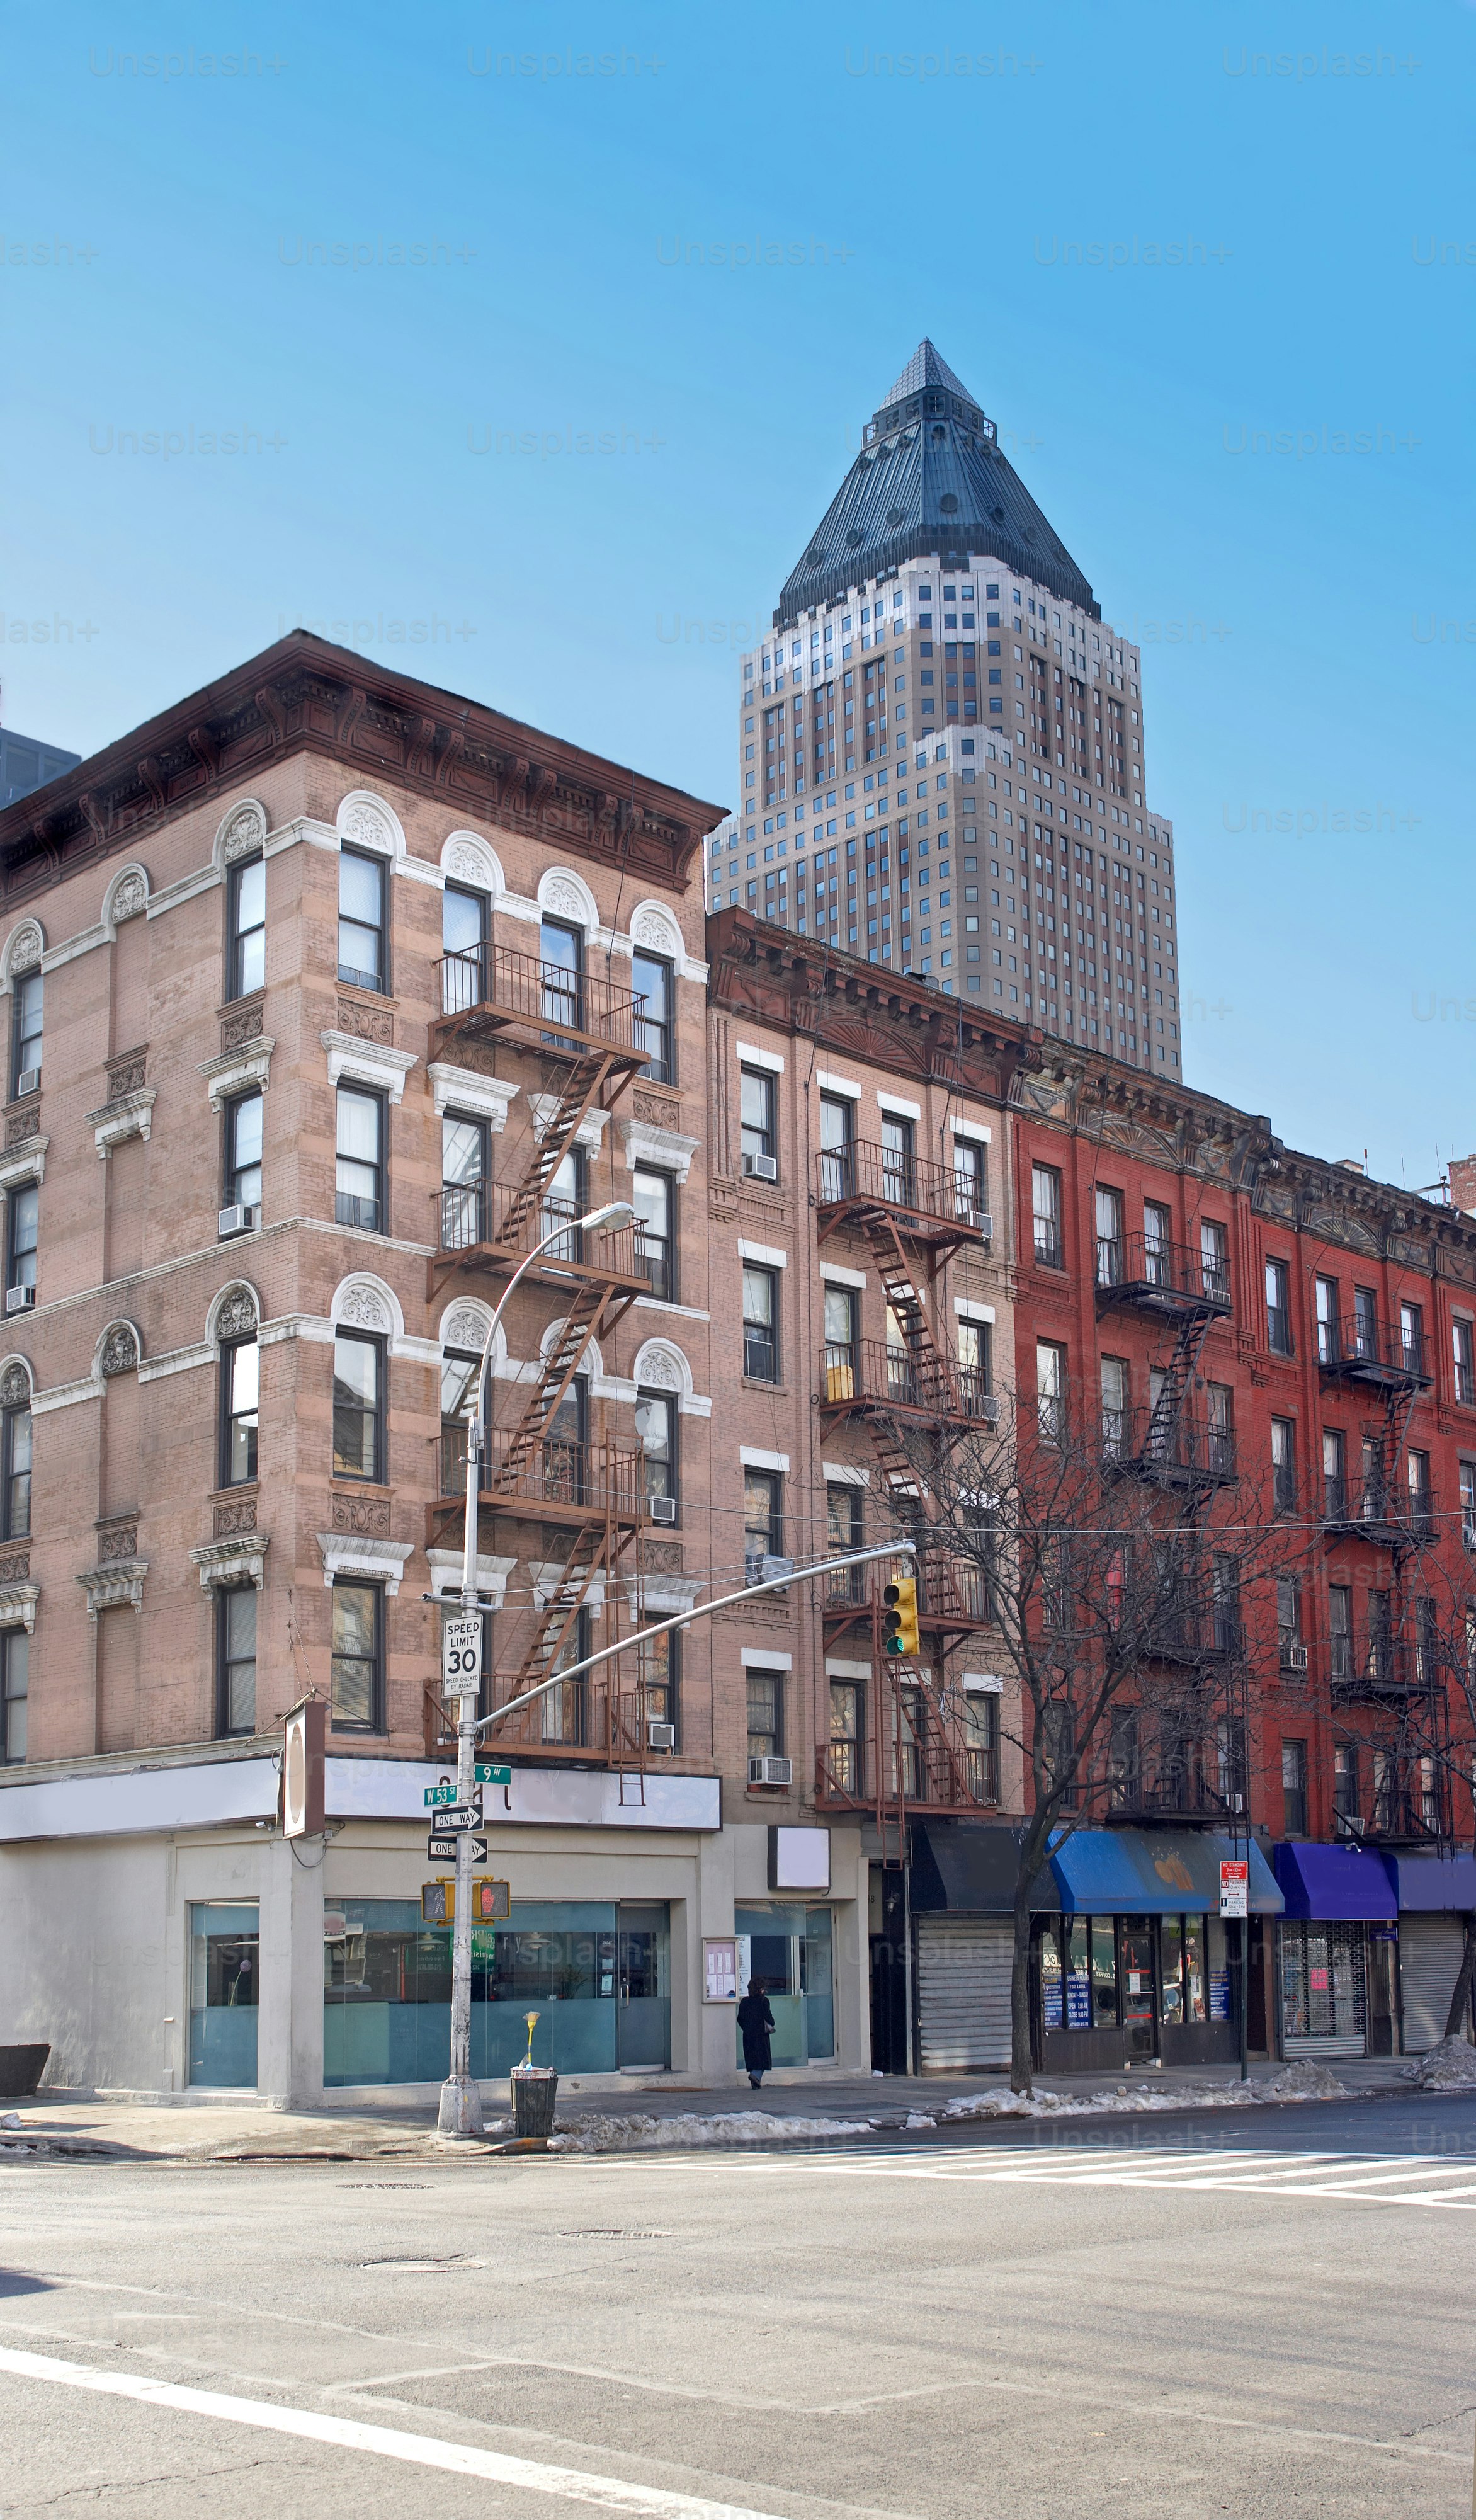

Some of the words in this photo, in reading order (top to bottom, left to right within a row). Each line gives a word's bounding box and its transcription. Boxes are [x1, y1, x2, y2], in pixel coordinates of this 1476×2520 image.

[448, 1622, 479, 1635] SPEED
[451, 1636, 475, 1648] LIMIT
[448, 1649, 476, 1674] 30
[484, 1767, 491, 1781] 9
[493, 1767, 501, 1776] AV
[427, 1789, 434, 1804] W
[436, 1787, 447, 1803] 53
[449, 1786, 456, 1795] ST
[439, 1815, 453, 1826] ONE
[460, 1813, 475, 1823] WAY
[436, 1844, 452, 1854] ONE
[472, 1845, 480, 1855] AY
